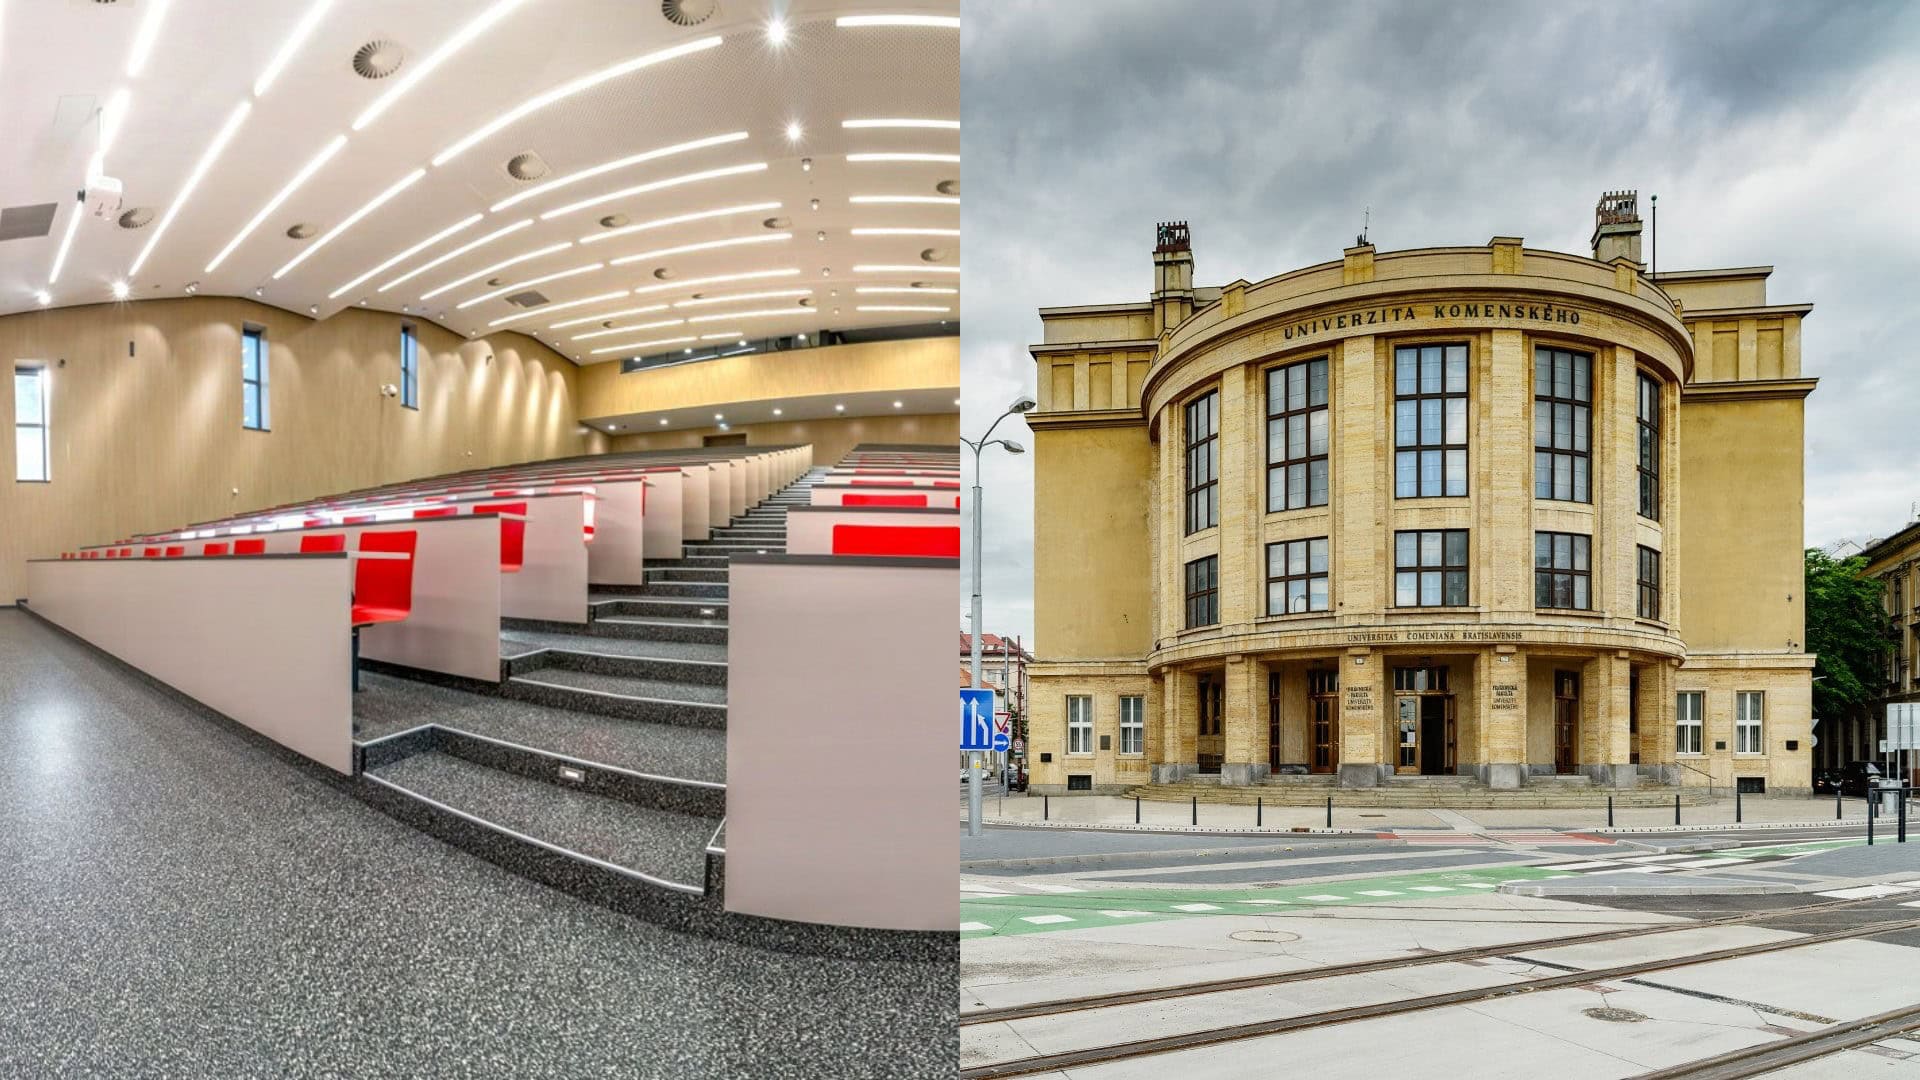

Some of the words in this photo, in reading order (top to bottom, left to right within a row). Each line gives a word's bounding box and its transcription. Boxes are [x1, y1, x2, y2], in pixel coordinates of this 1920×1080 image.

[1284, 307, 1416, 340] UNIVERZITA
[1434, 303, 1580, 325] KOMENSKÉHO
[1347, 633, 1398, 642] UNIVERSITAS
[1406, 631, 1455, 640] COMENIANA
[1462, 631, 1522, 640] BRATISLAVENSIS
